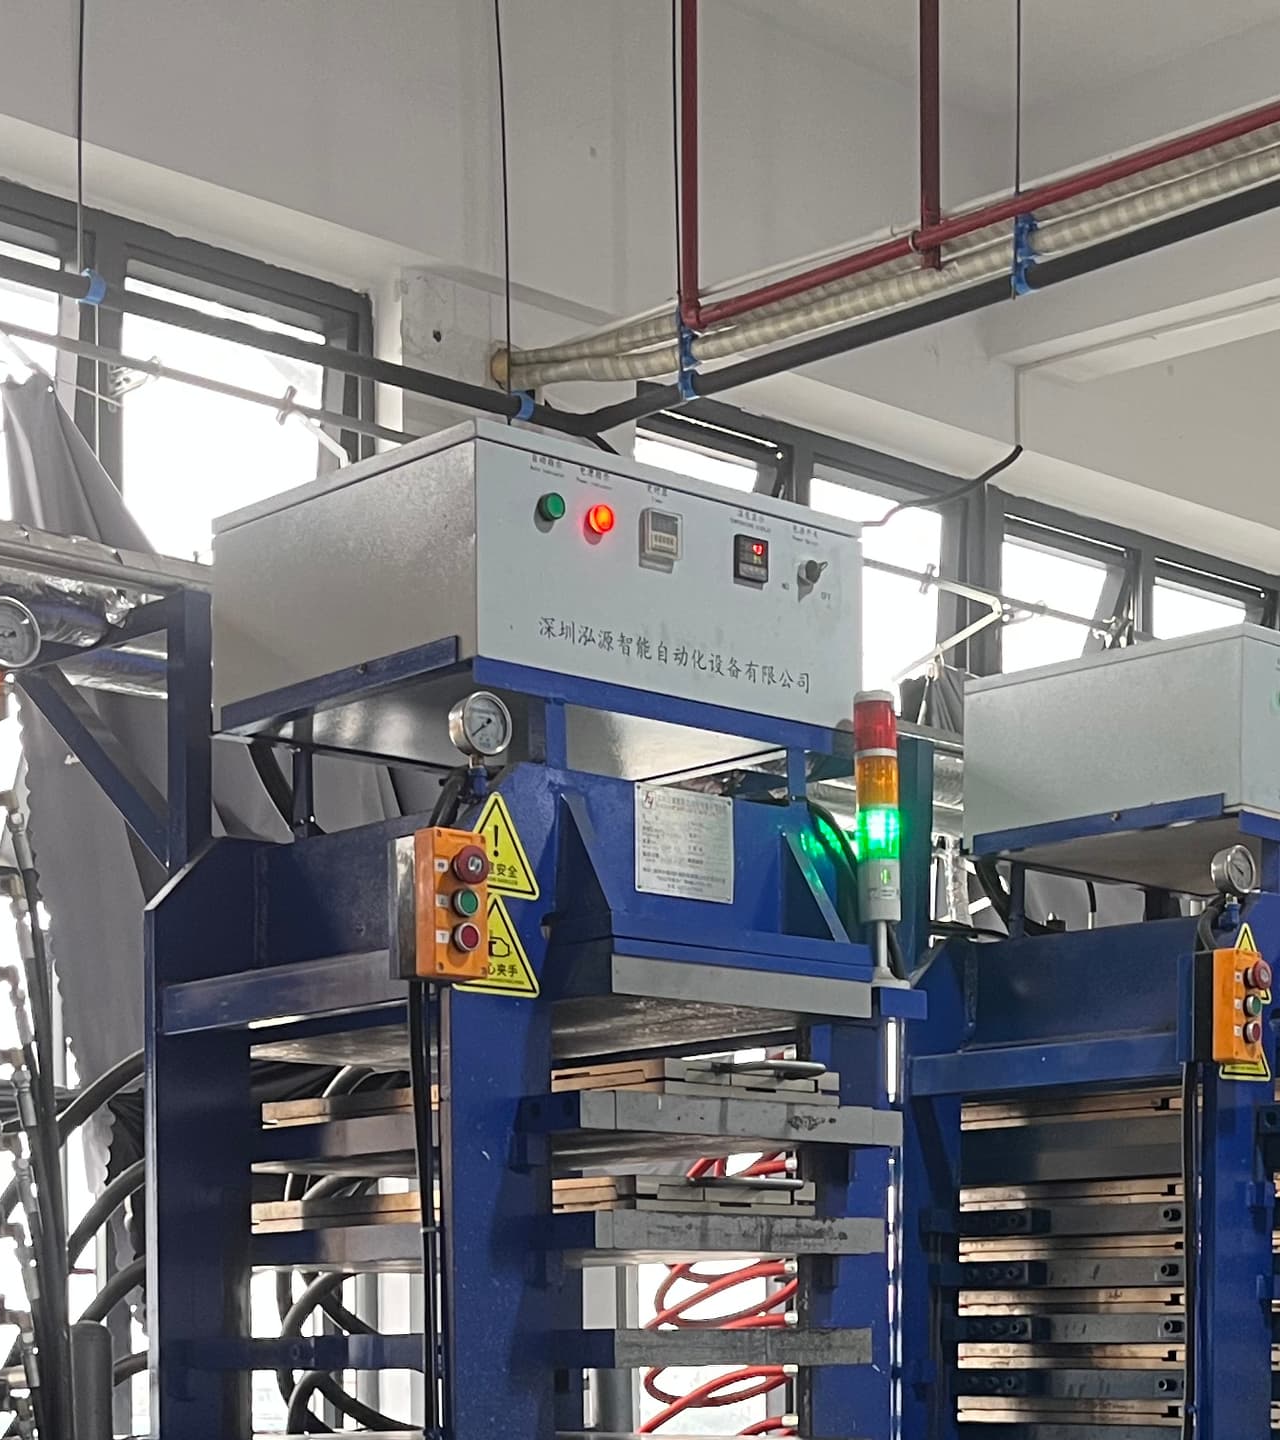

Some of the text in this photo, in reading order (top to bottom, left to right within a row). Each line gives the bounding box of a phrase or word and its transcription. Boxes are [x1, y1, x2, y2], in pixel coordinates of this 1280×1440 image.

[538, 616, 811, 694] 深圳泓源智能自动化设备有限公司
[489, 862, 519, 879] 安全
